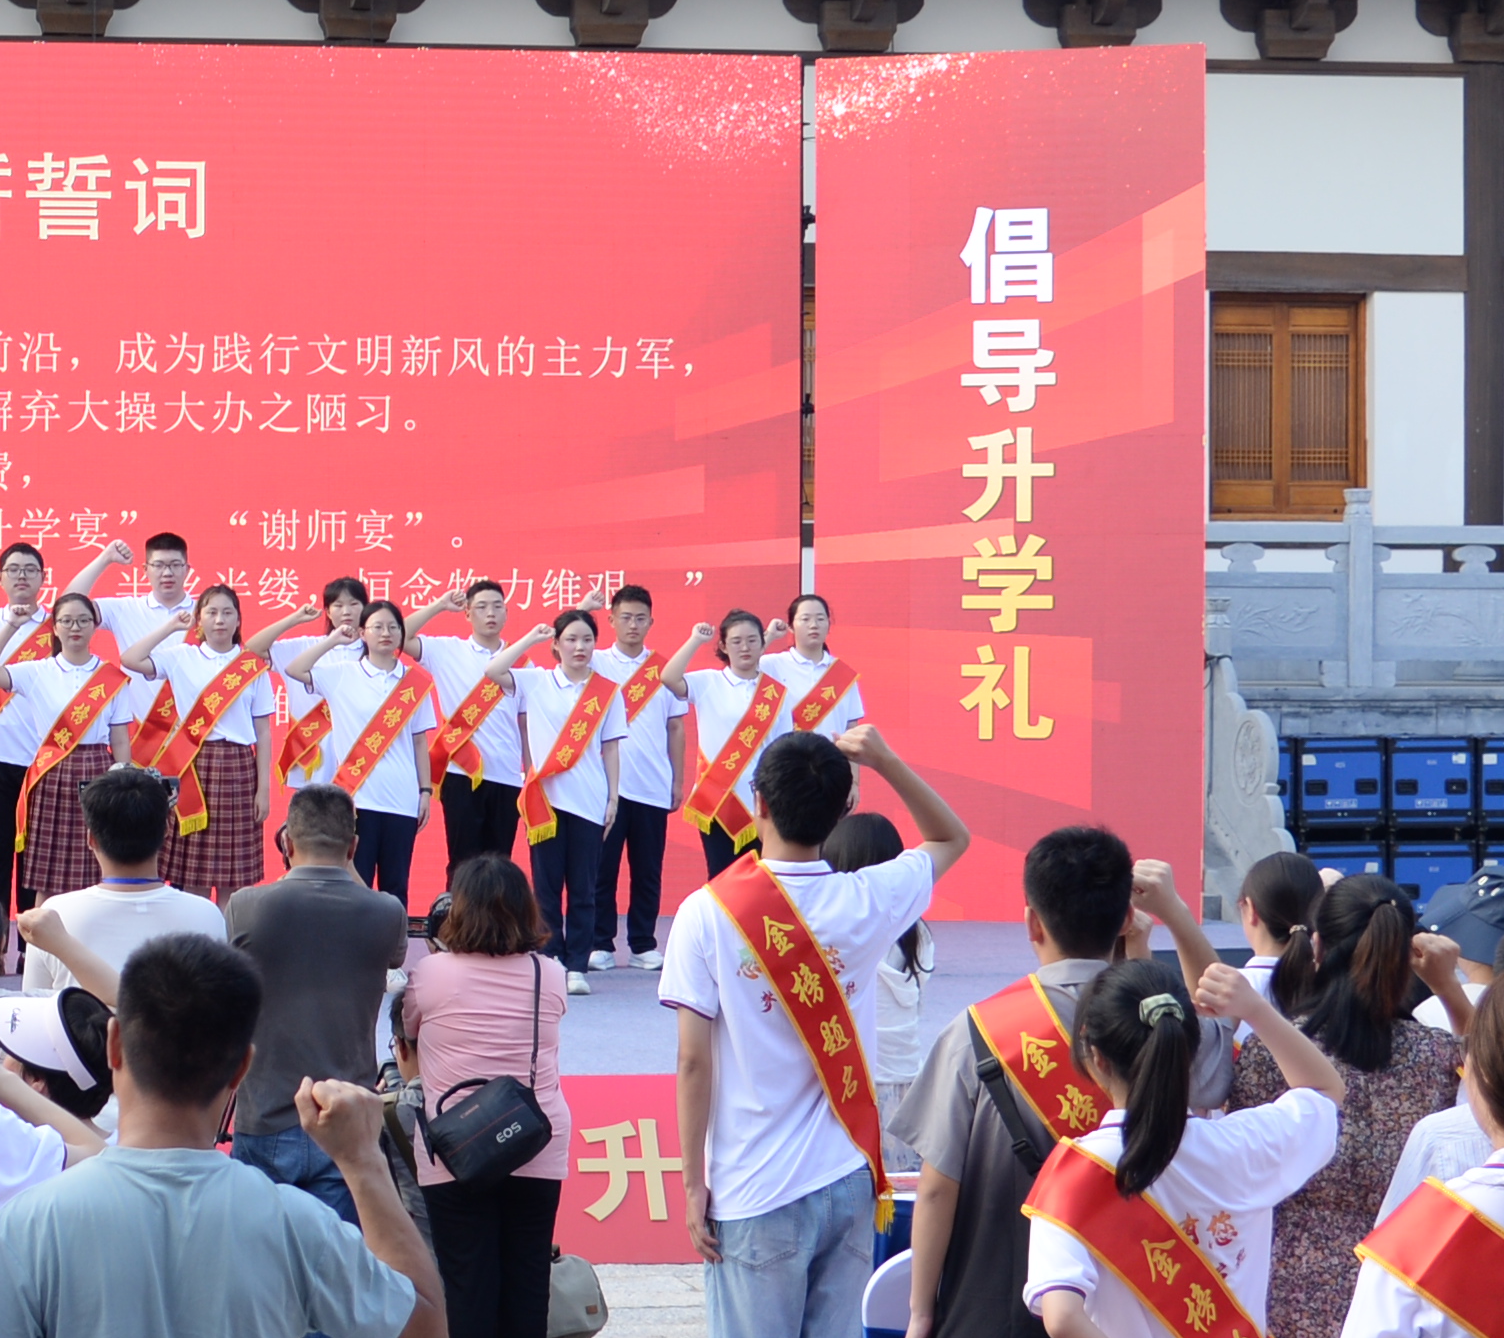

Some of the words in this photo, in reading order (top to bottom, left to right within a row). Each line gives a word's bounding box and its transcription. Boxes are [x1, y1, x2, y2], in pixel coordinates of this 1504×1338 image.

[959, 205, 1056, 742] 倡导升学礼
[189, 657, 258, 736] 金榜题名
[347, 687, 418, 778] 金榜题名
[721, 683, 780, 771] 金榜题名
[762, 915, 858, 1104] 金榜题名
[495, 1121, 523, 1144] EOS
[577, 1118, 684, 1223] 升
